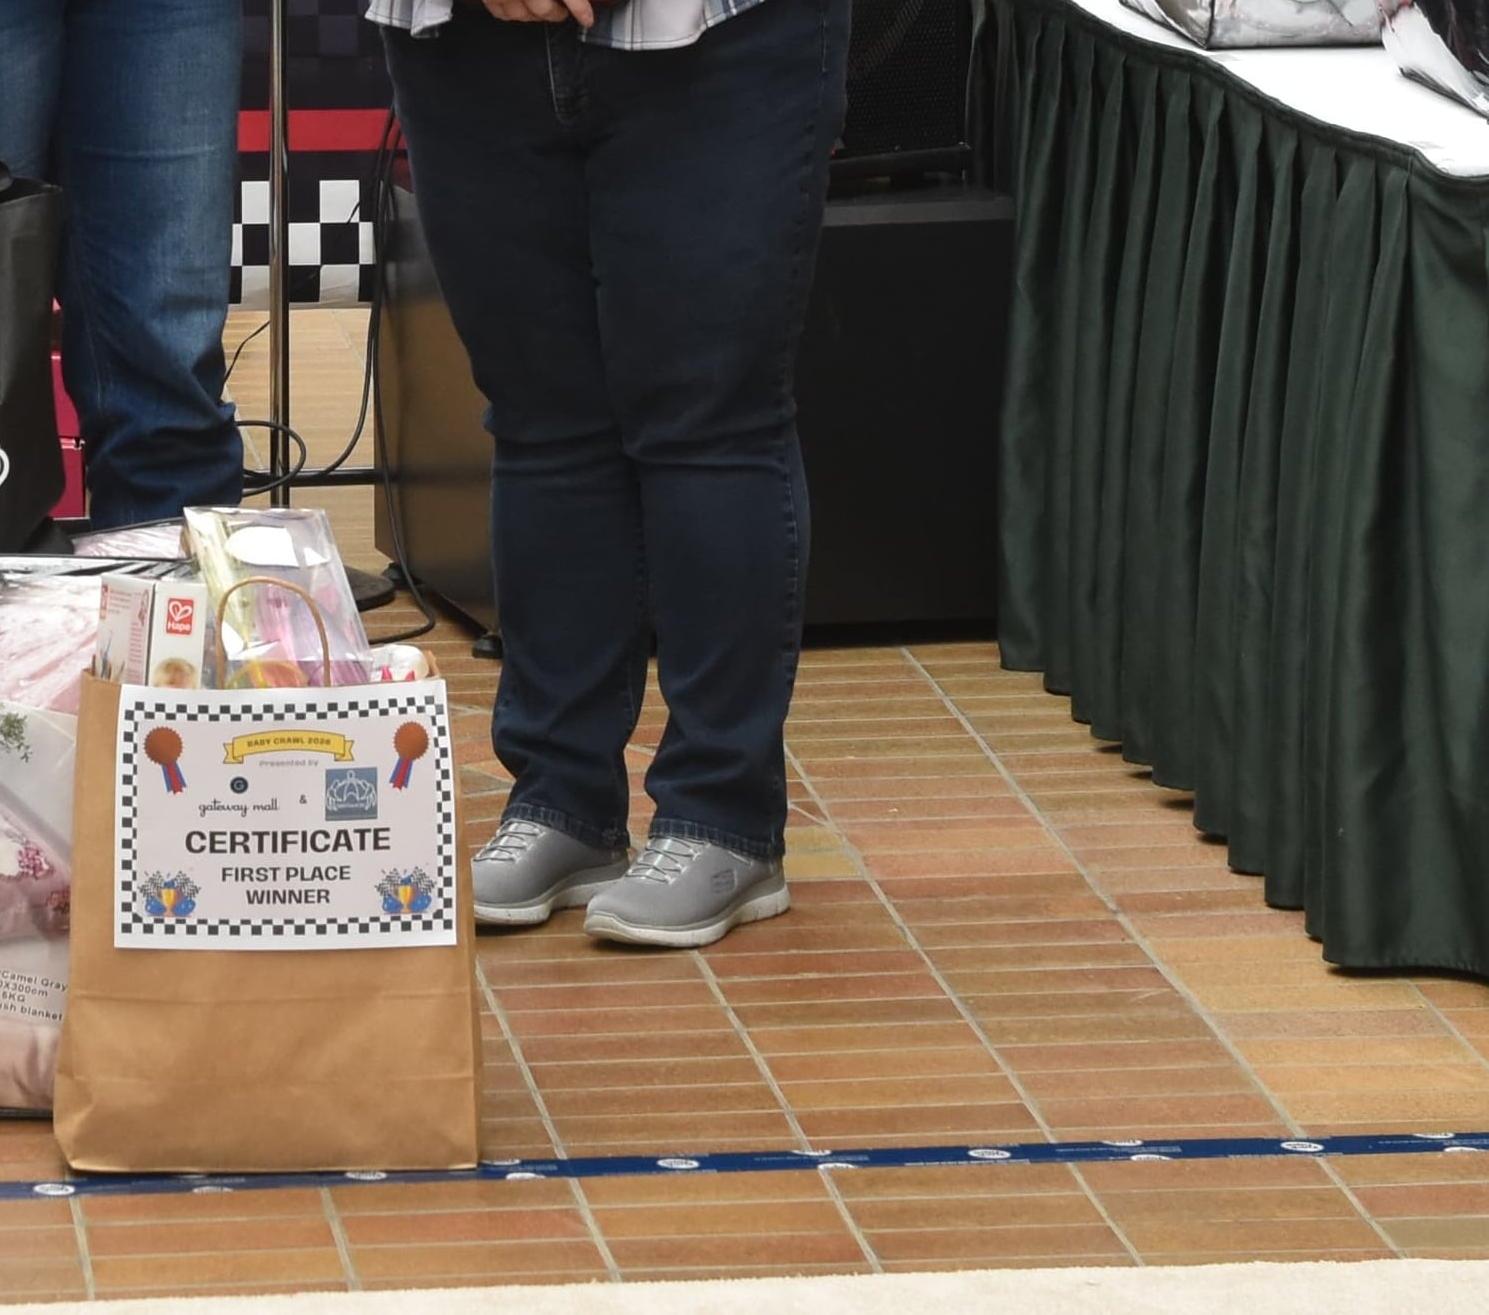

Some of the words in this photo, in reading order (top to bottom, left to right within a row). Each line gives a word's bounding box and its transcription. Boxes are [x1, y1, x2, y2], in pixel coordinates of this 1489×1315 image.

[167, 621, 192, 633] Hape
[246, 737, 271, 748] BABY
[273, 736, 305, 746] CRAWL
[198, 798, 249, 817] gateway
[253, 798, 280, 811] mall
[298, 794, 308, 805] &
[185, 827, 392, 855] CERTIFICATE
[221, 866, 281, 883] FIRST
[285, 865, 352, 882] PLACE
[246, 888, 331, 905] WINNER
[20, 1005, 64, 1022] blanket
